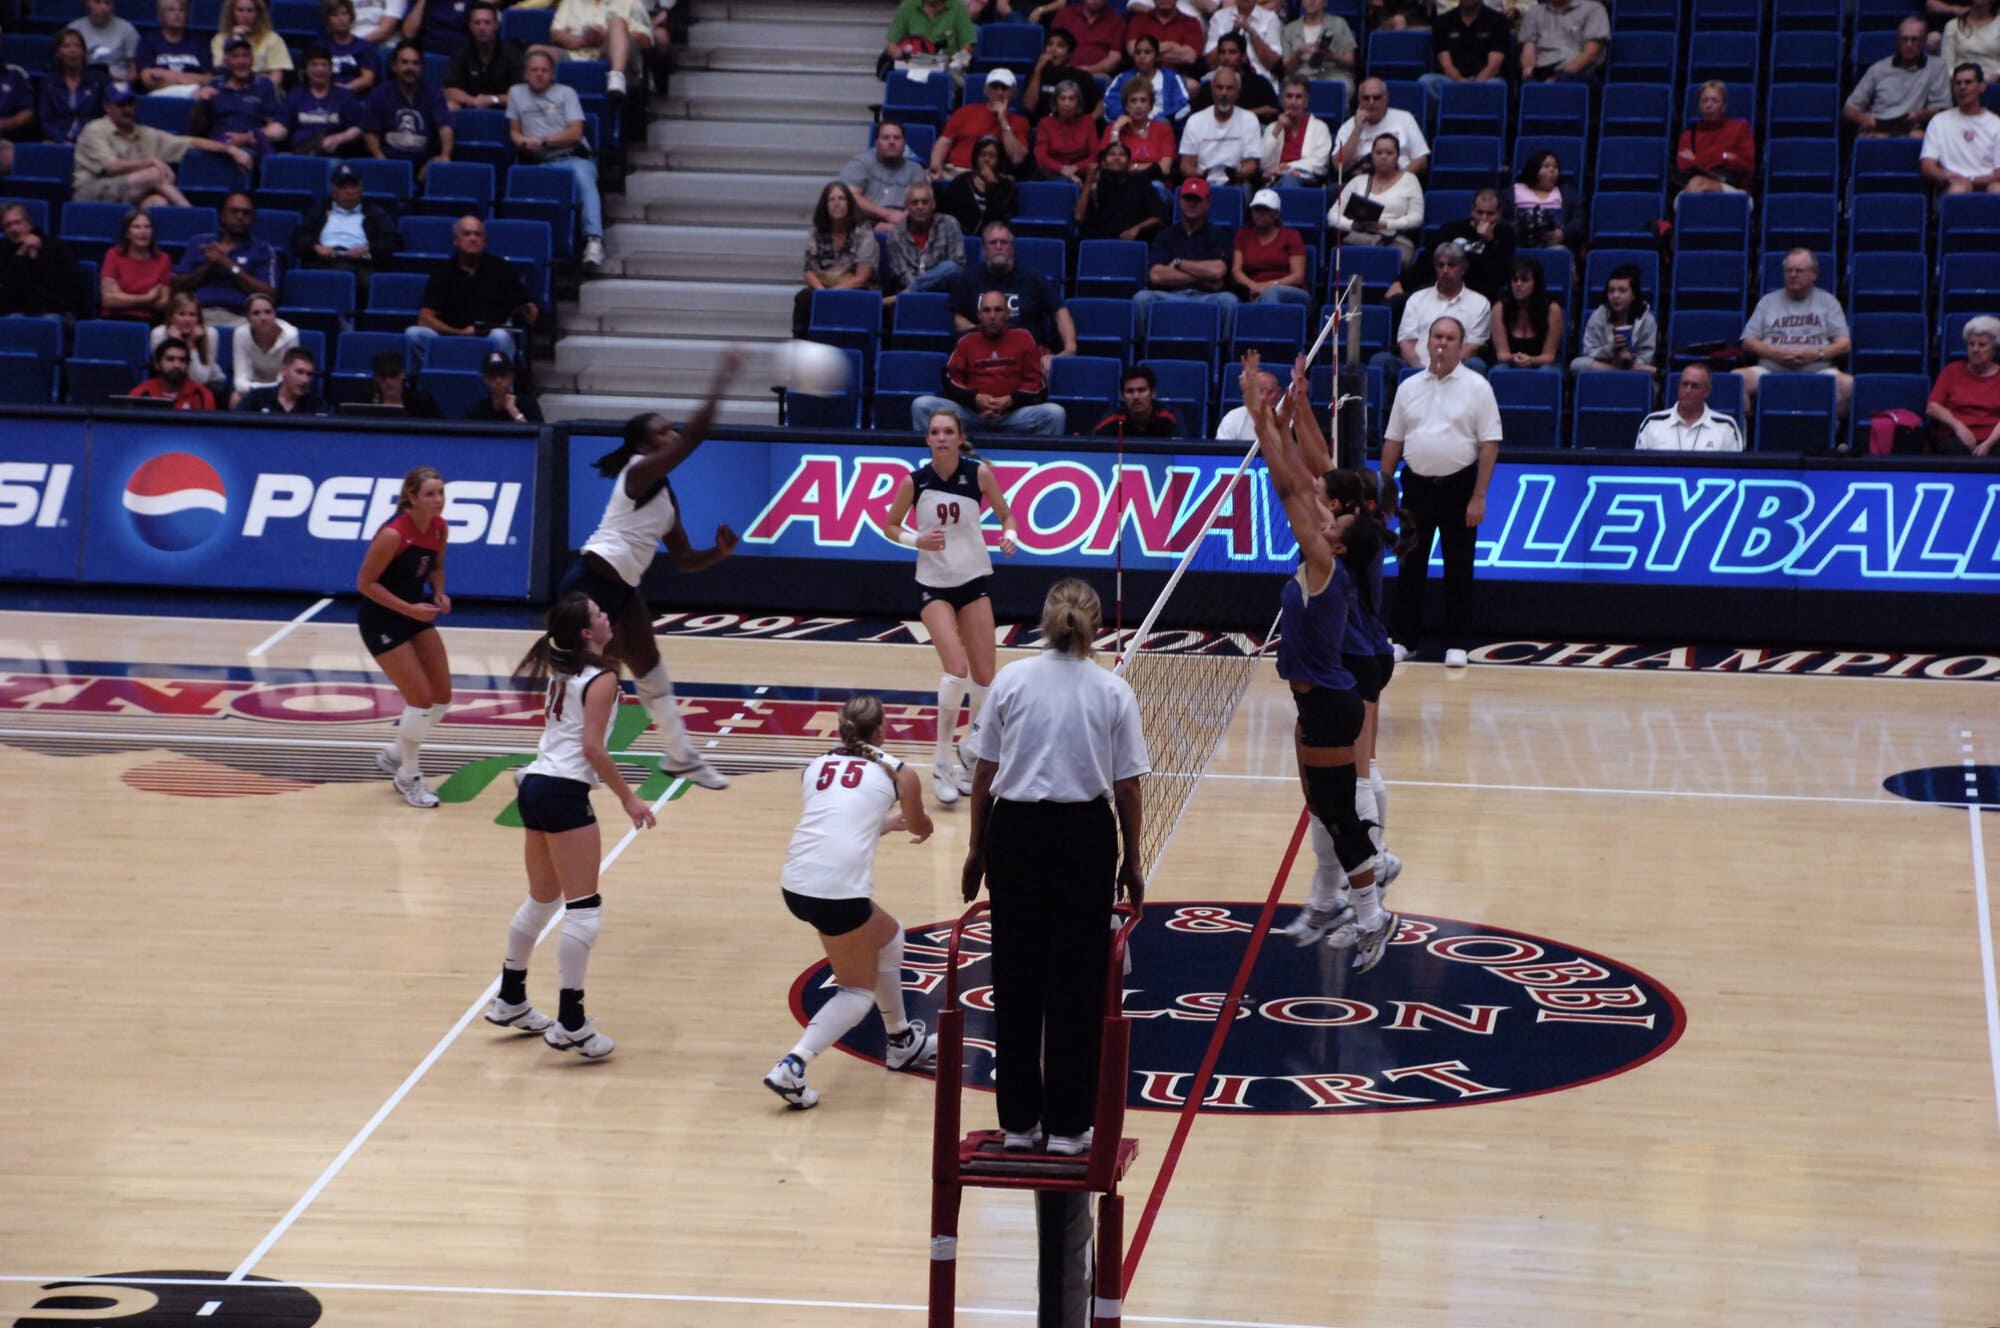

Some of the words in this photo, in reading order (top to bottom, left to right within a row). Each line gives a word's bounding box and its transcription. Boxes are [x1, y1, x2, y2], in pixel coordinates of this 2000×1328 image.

[743, 454, 1258, 561] ARZONA
[936, 501, 961, 526] 99
[651, 612, 856, 639] 1997
[815, 760, 868, 791] 55
